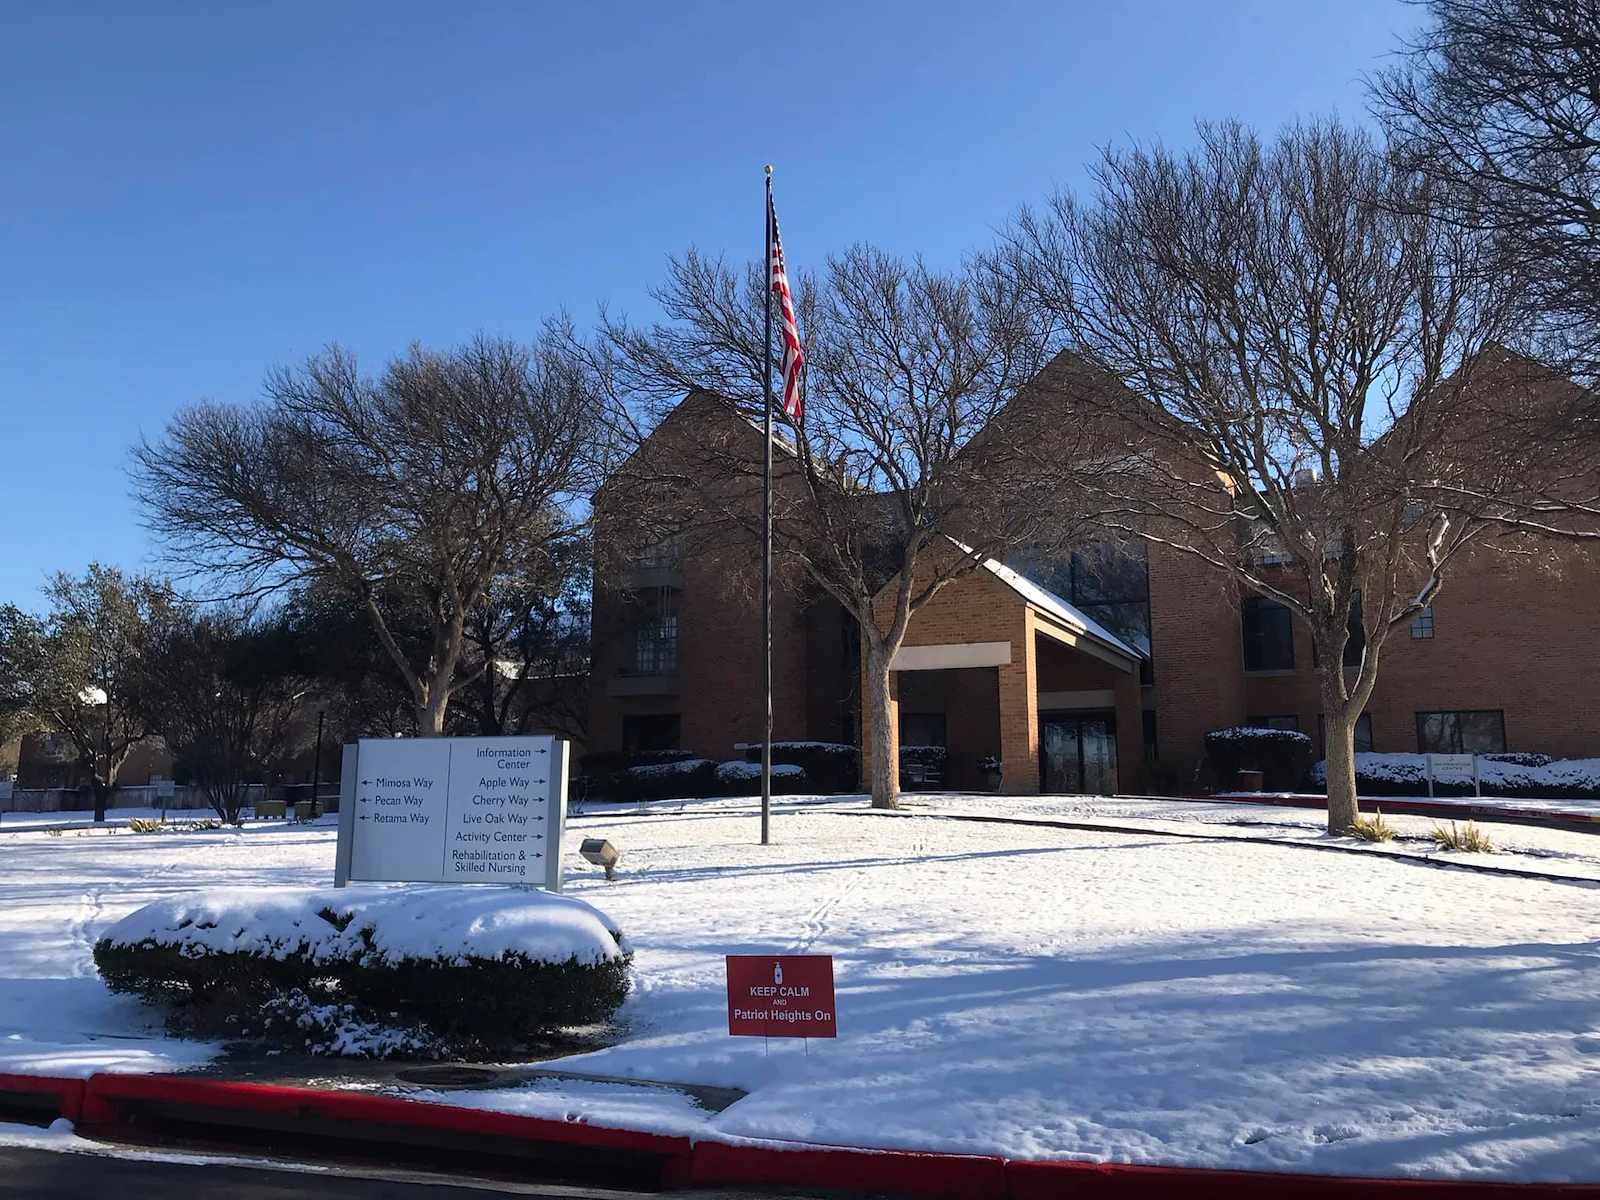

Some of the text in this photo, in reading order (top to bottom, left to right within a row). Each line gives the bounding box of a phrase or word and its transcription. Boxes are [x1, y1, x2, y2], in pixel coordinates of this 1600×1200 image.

[476, 748, 531, 757] Information
[497, 760, 530, 769] Center
[376, 778, 433, 790] Mimosa Way
[479, 777, 530, 788] Apple Way
[375, 796, 424, 807] Pecan Way
[472, 795, 528, 807] Cherry Way
[374, 814, 430, 825] Retama Way
[463, 814, 528, 825] Live Oak Way
[455, 831, 527, 843] Activity Center
[452, 850, 526, 860] Rehabilitation &
[455, 862, 526, 875] Skilled Nursing
[750, 987, 810, 996] KEEP CALM
[735, 1009, 831, 1023] Patriot Heights On
